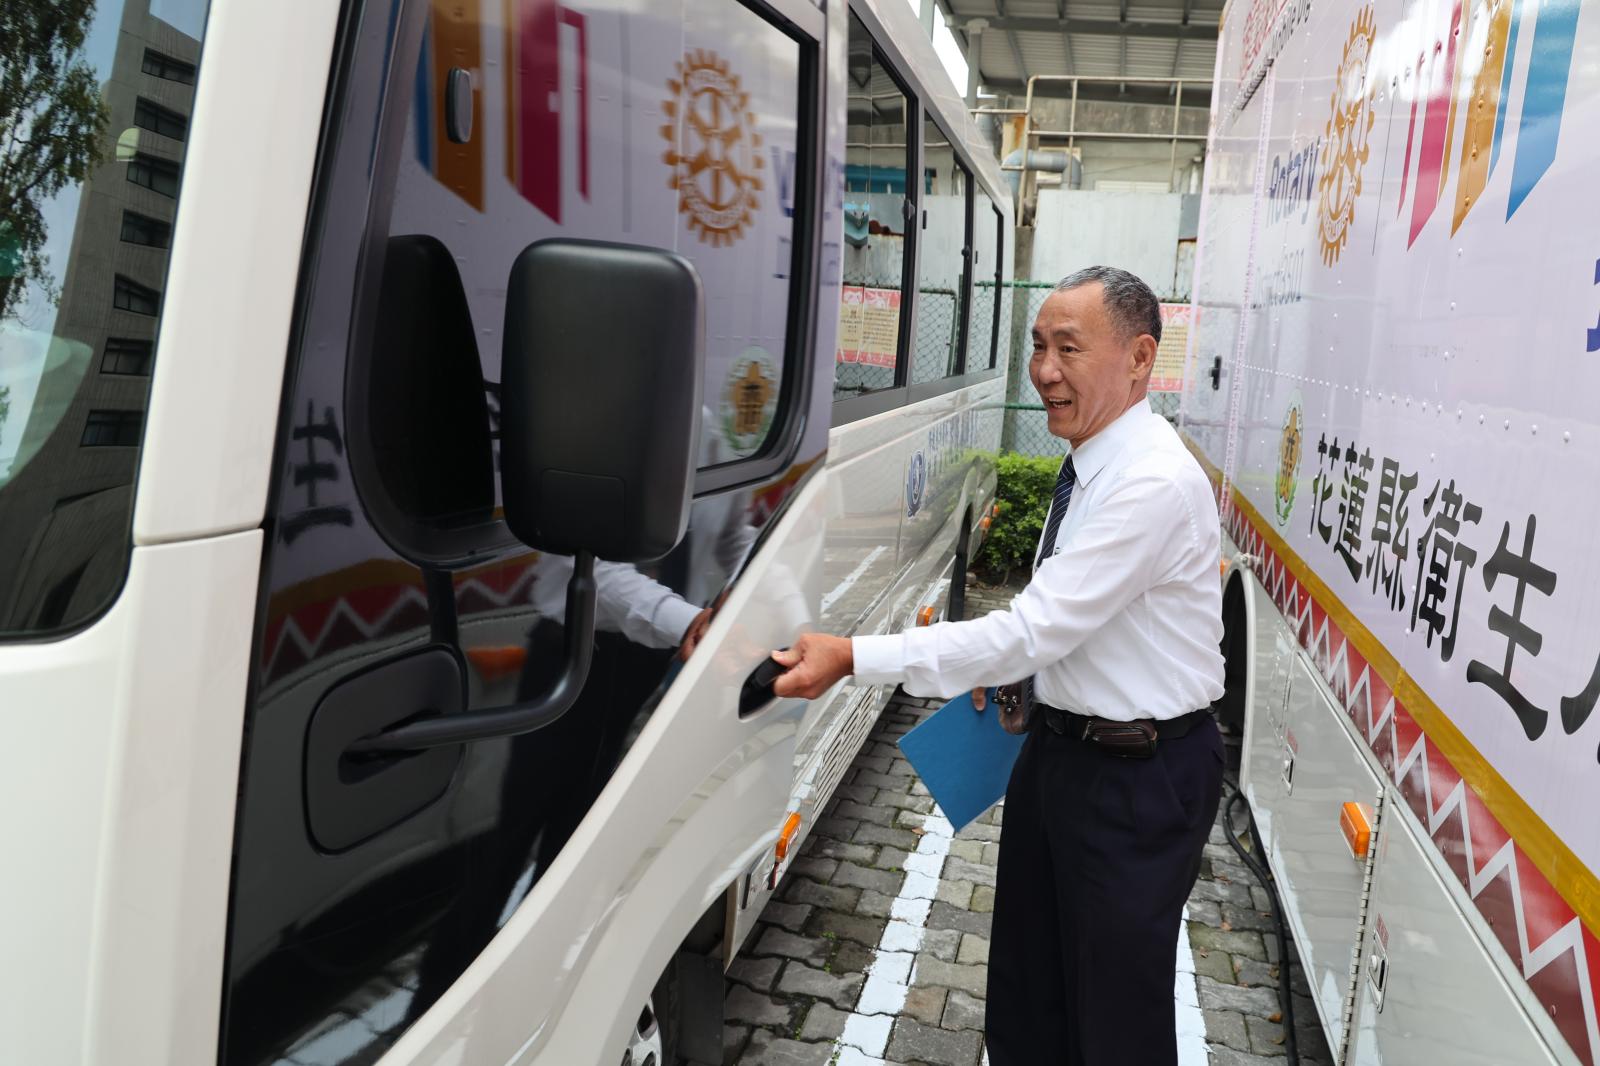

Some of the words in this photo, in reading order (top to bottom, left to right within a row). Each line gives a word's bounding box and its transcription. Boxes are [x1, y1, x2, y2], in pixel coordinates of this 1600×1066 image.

[1266, 136, 1321, 228] Rotary
[1310, 432, 1600, 766] 花蓮縣衛生
